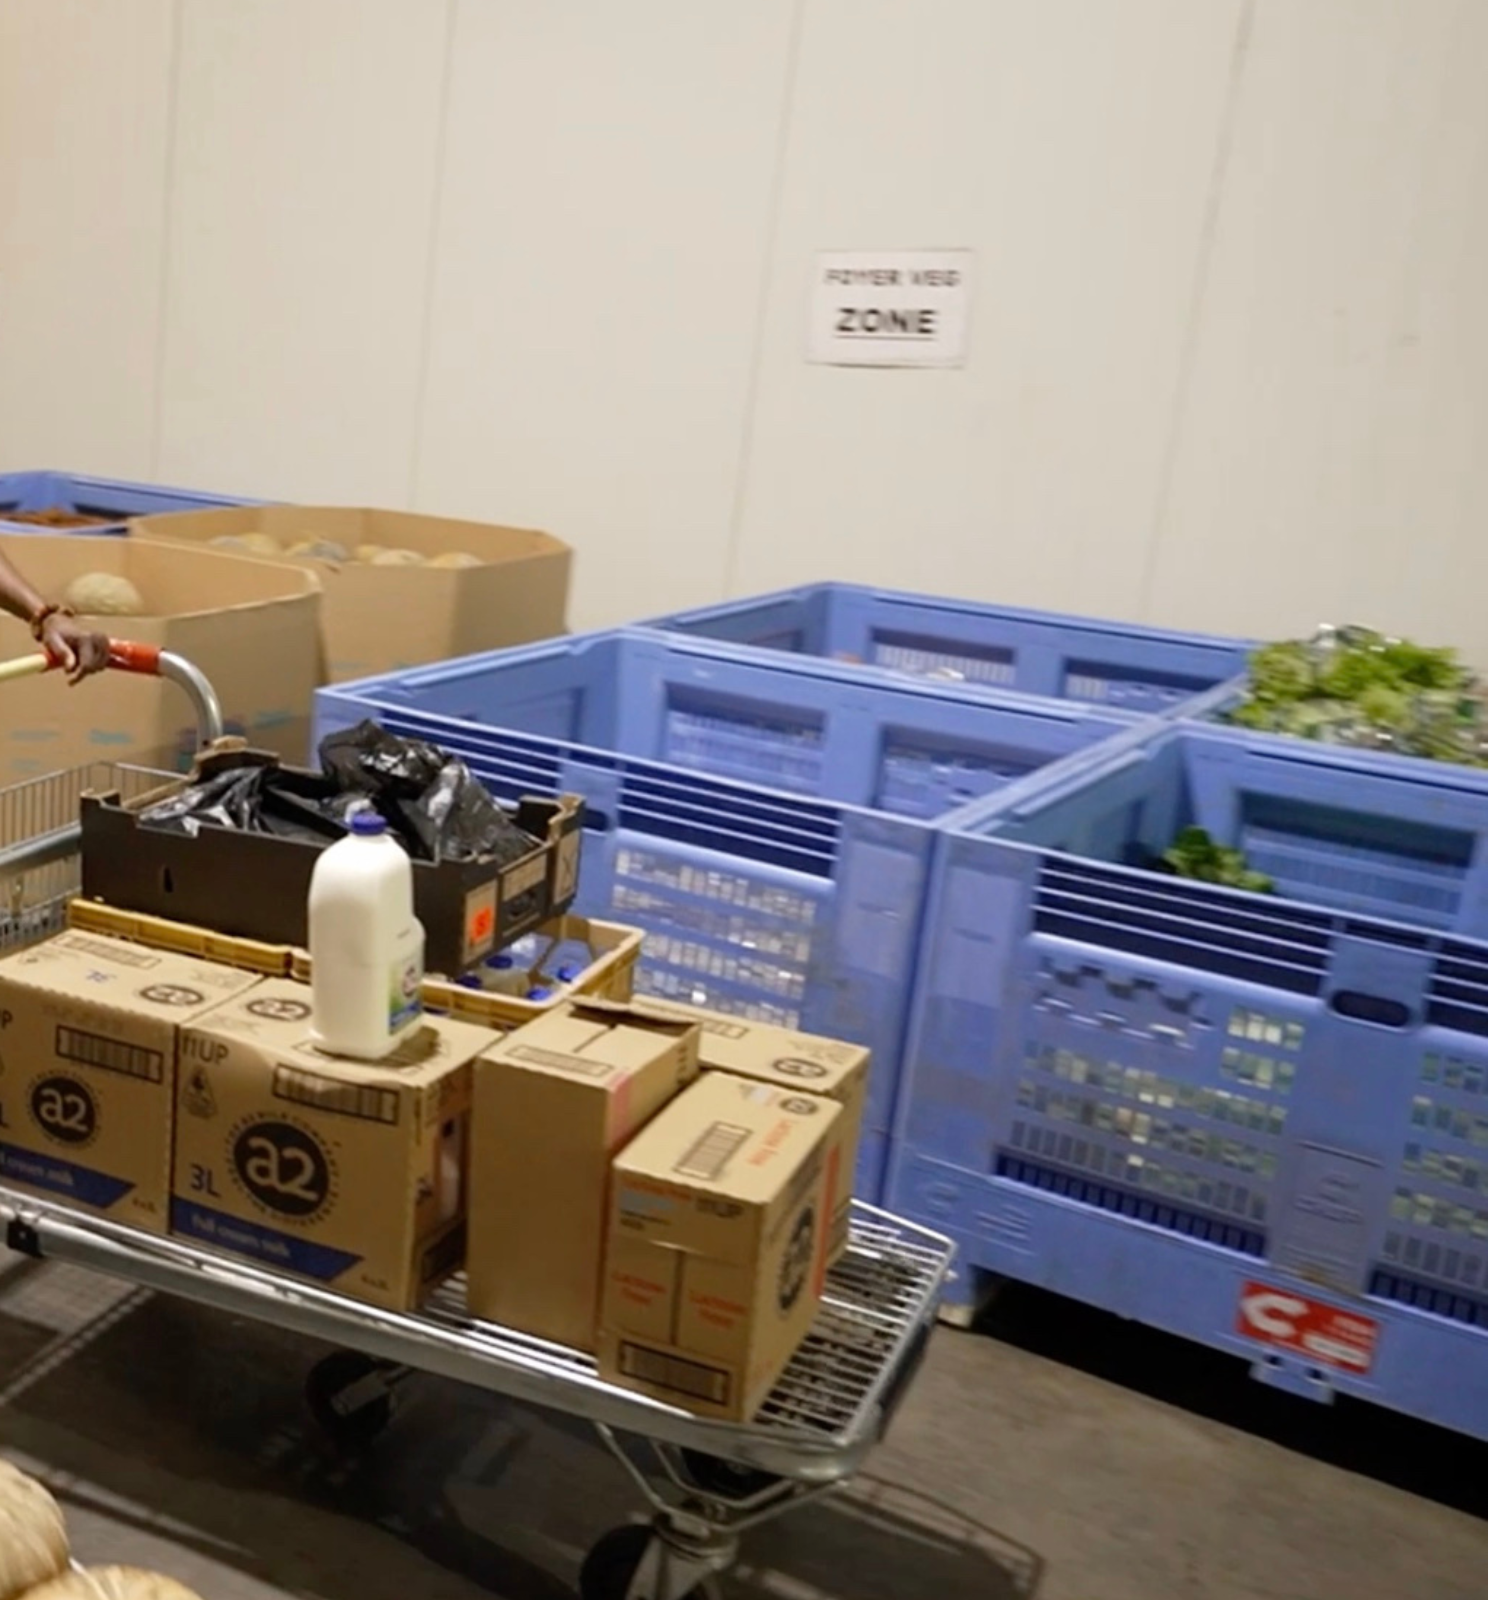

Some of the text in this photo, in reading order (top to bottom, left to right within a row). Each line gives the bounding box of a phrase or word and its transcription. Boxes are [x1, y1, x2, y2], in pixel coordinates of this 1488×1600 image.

[835, 306, 936, 334] ZONE
[39, 1087, 89, 1133] a2
[188, 1163, 222, 1199] 3L
[244, 1135, 319, 1202] a2
